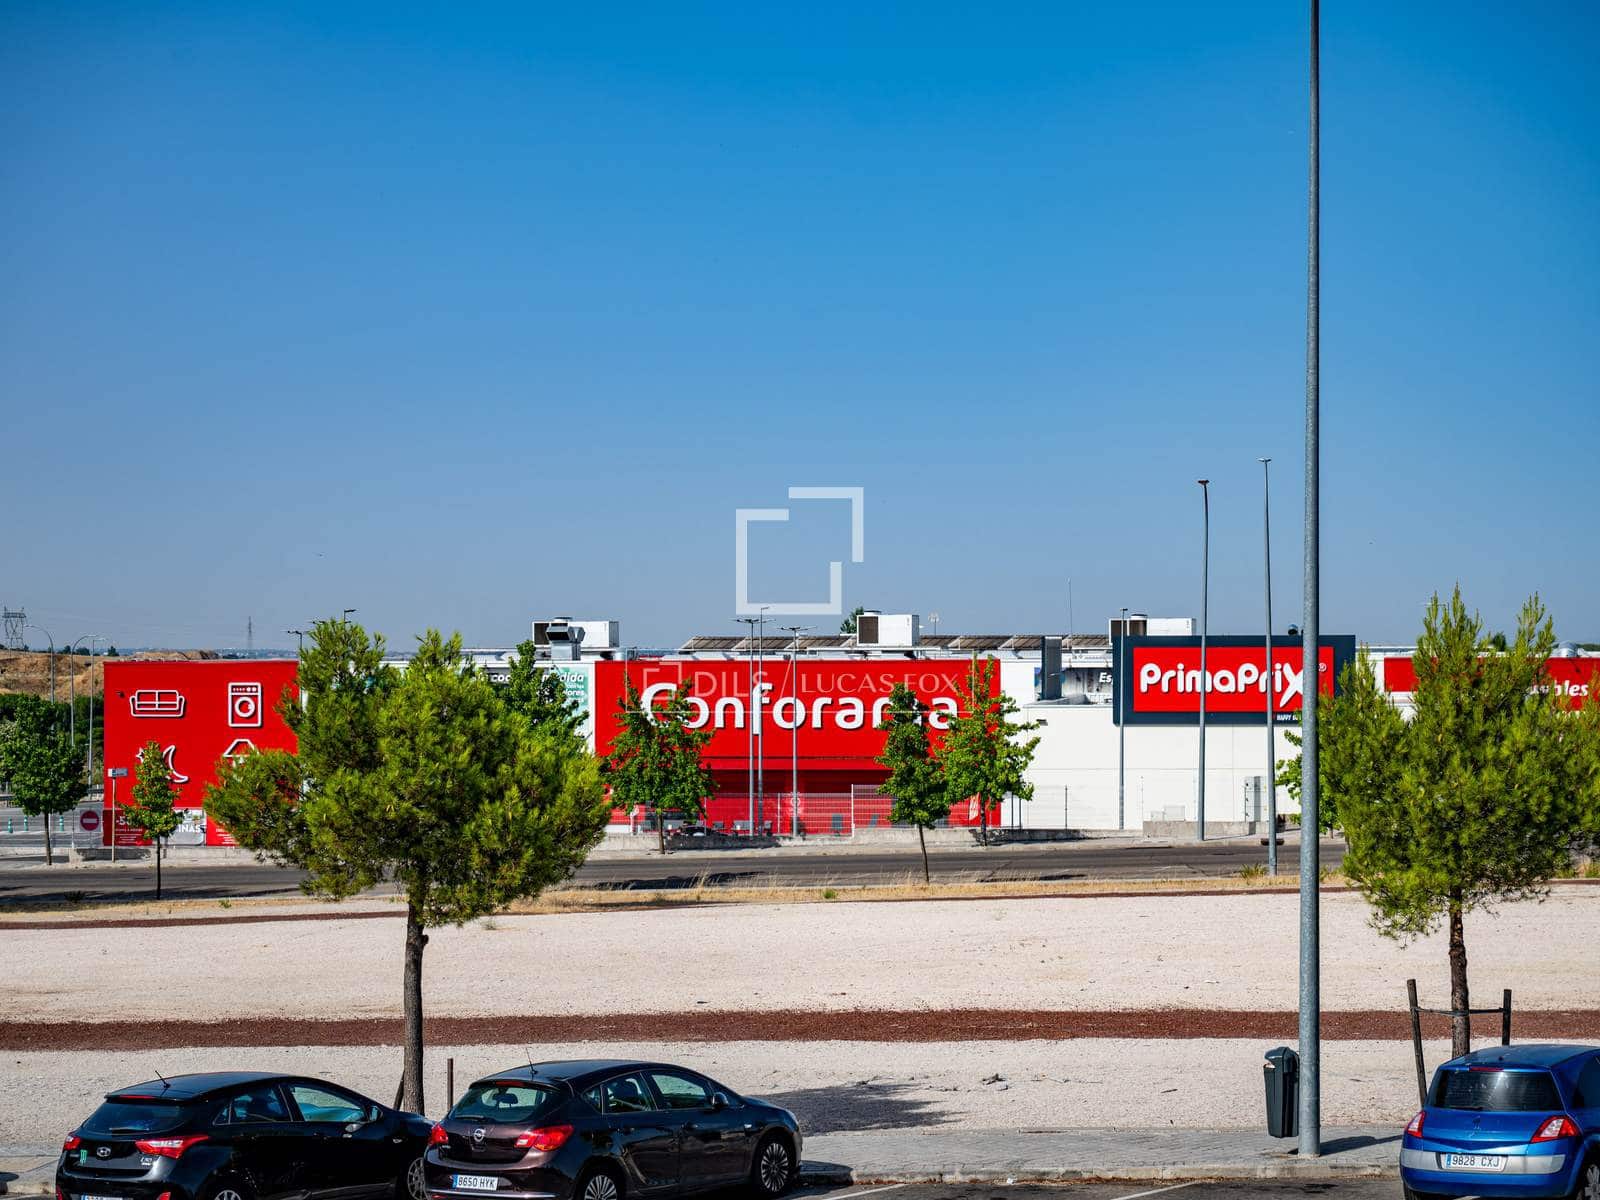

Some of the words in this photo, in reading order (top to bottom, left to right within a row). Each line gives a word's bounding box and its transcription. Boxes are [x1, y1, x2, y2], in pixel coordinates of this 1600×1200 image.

[1452, 1155, 1476, 1166] 9828
[1481, 1156, 1500, 1167] CXJ
[479, 1177, 495, 1189] HYK
